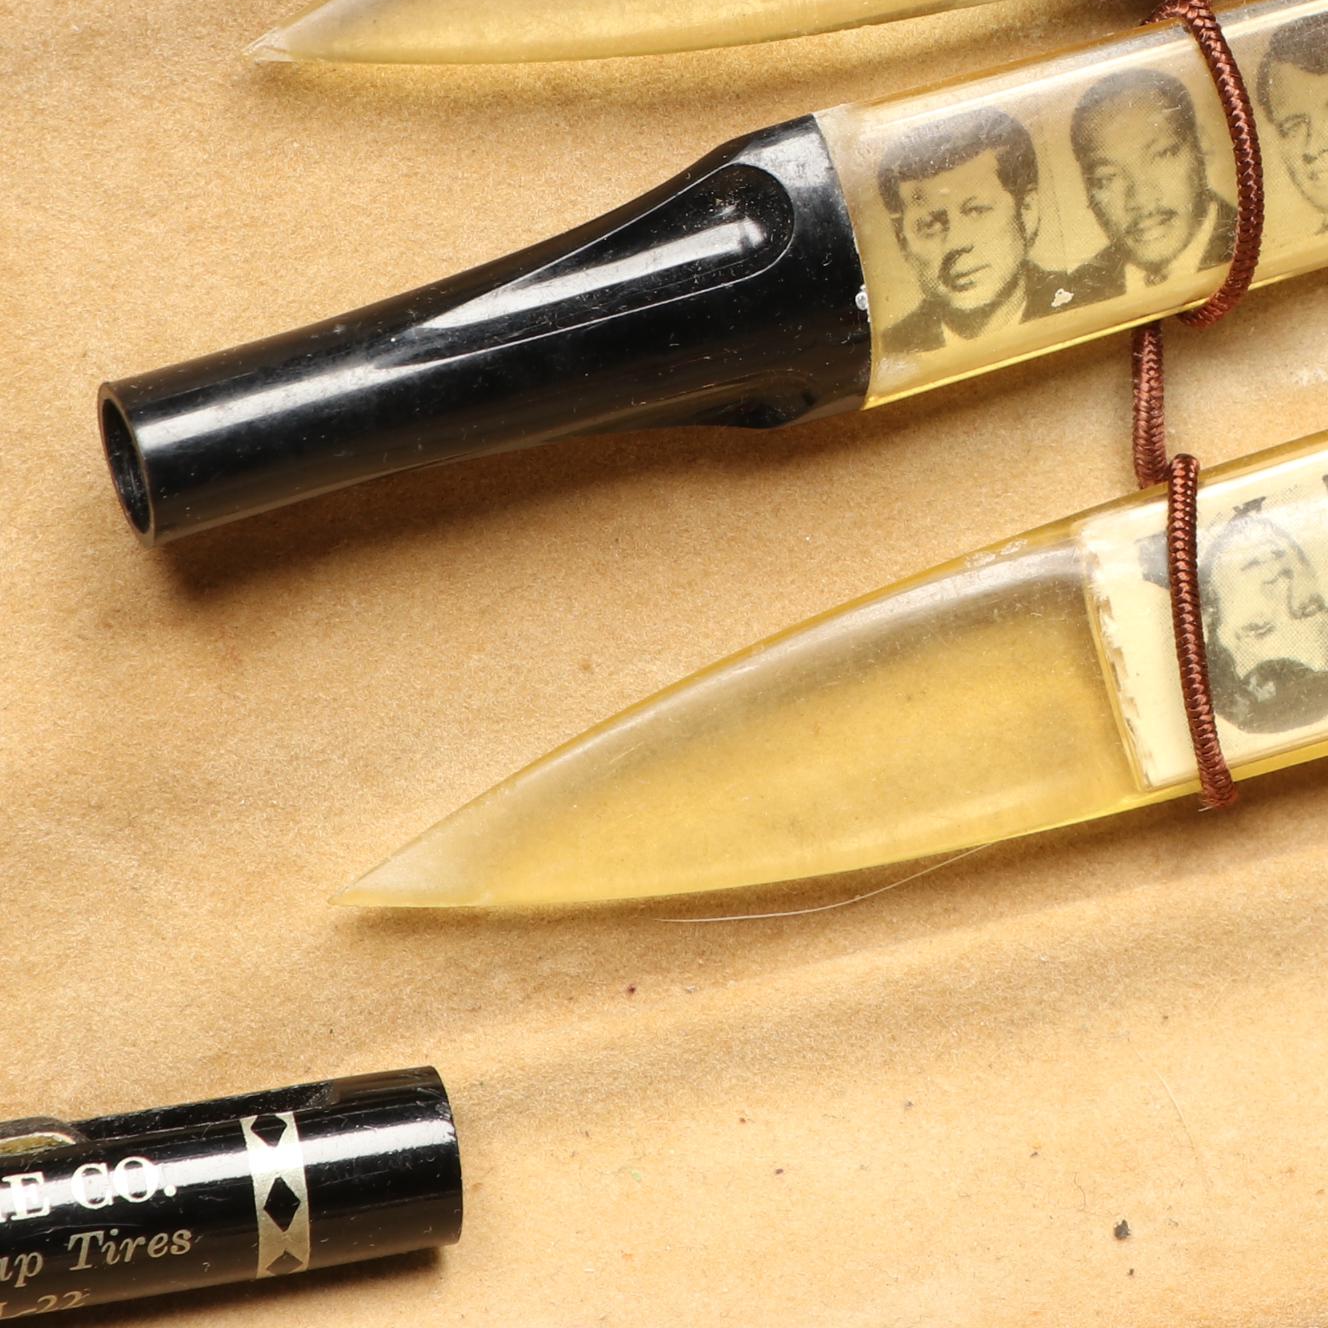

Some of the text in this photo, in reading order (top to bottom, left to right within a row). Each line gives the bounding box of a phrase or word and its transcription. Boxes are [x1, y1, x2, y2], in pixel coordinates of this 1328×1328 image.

[0, 1156, 177, 1223] E CO.
[67, 1228, 193, 1272] Tires
